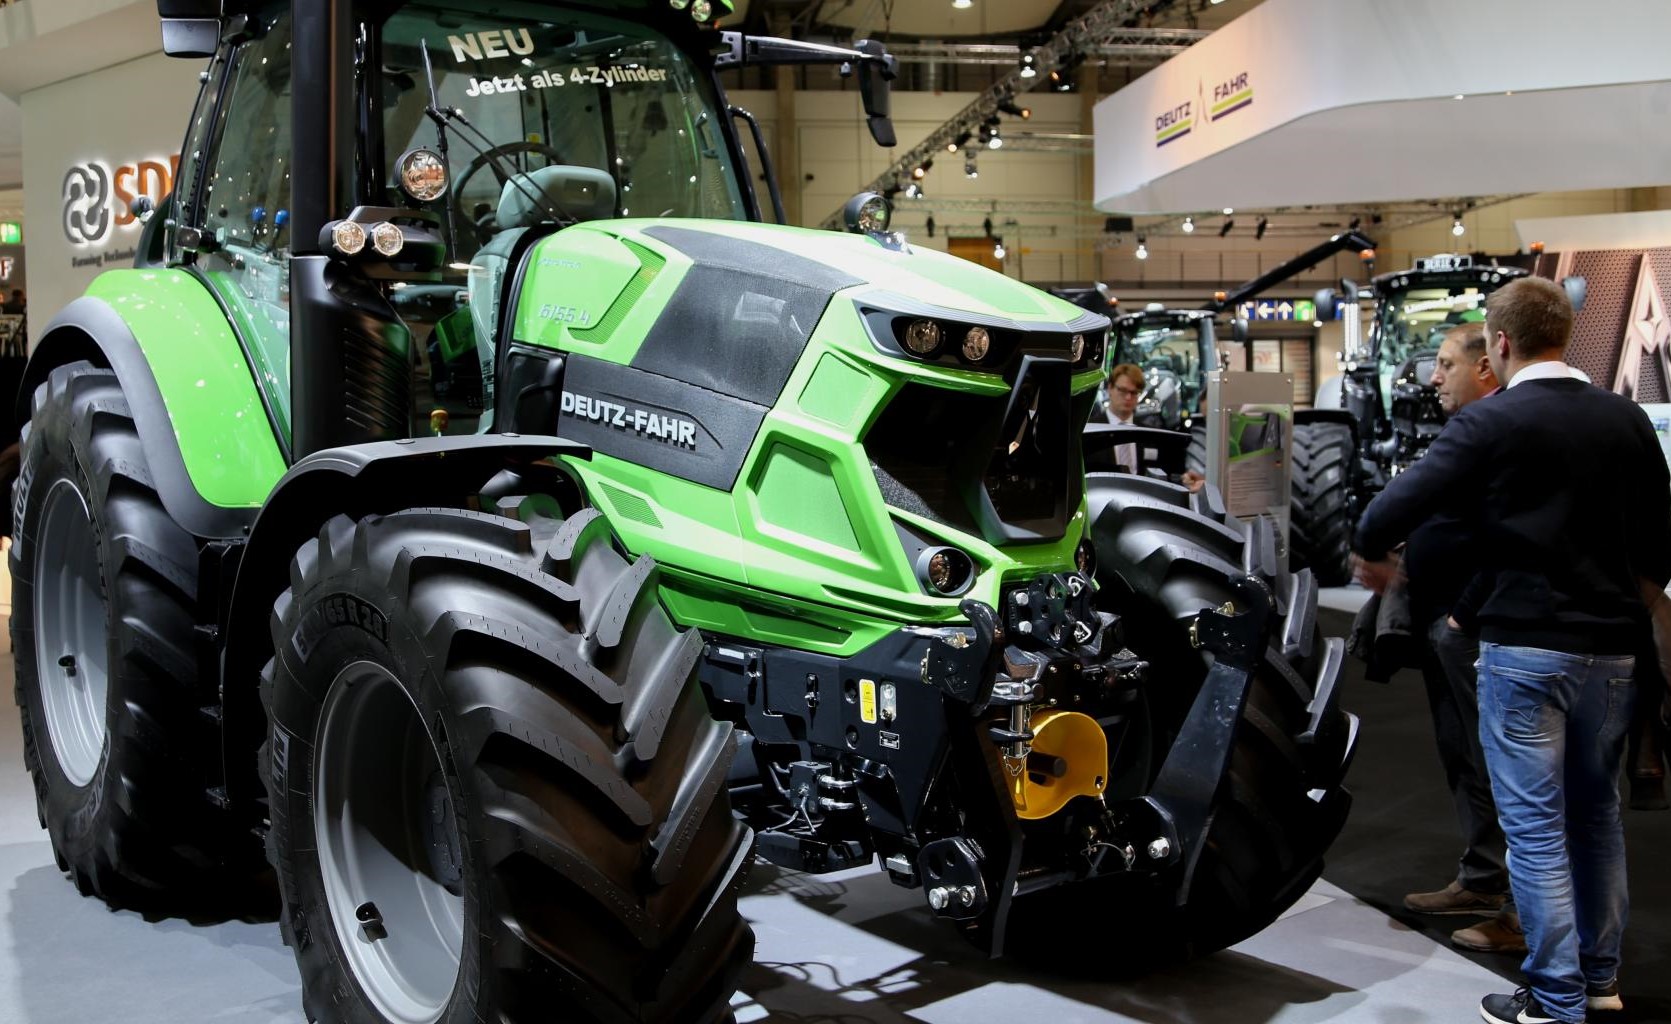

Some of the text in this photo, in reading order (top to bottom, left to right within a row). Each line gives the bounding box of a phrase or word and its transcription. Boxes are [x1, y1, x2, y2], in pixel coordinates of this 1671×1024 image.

[447, 28, 534, 62] NEU
[466, 66, 666, 97] Jetzt als 4-Zylinder
[1156, 72, 1248, 131] DEUTZ FAHR
[561, 391, 696, 446] DEUTZ-FAHR
